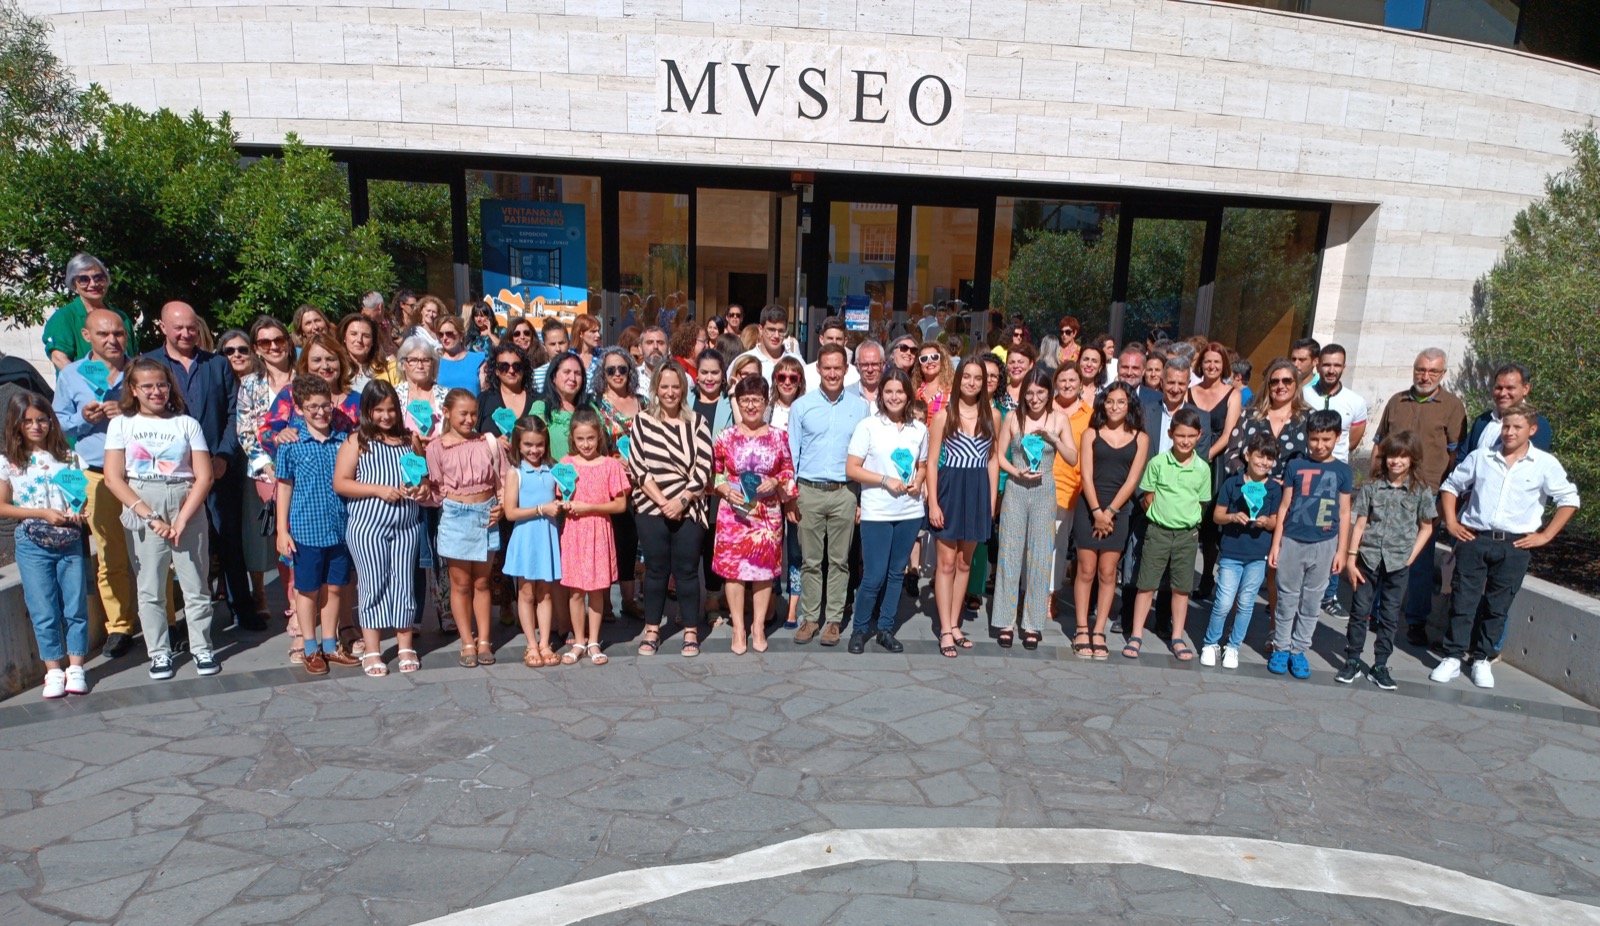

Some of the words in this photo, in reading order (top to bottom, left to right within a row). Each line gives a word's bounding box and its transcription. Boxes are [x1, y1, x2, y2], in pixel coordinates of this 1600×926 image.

[660, 59, 952, 126] MVSEO
[501, 207, 551, 217] VENTANAS
[553, 209, 563, 218] AL
[504, 215, 565, 225] PATRIMONIO
[133, 431, 158, 441] HAPPY
[160, 433, 176, 442] LIFE
